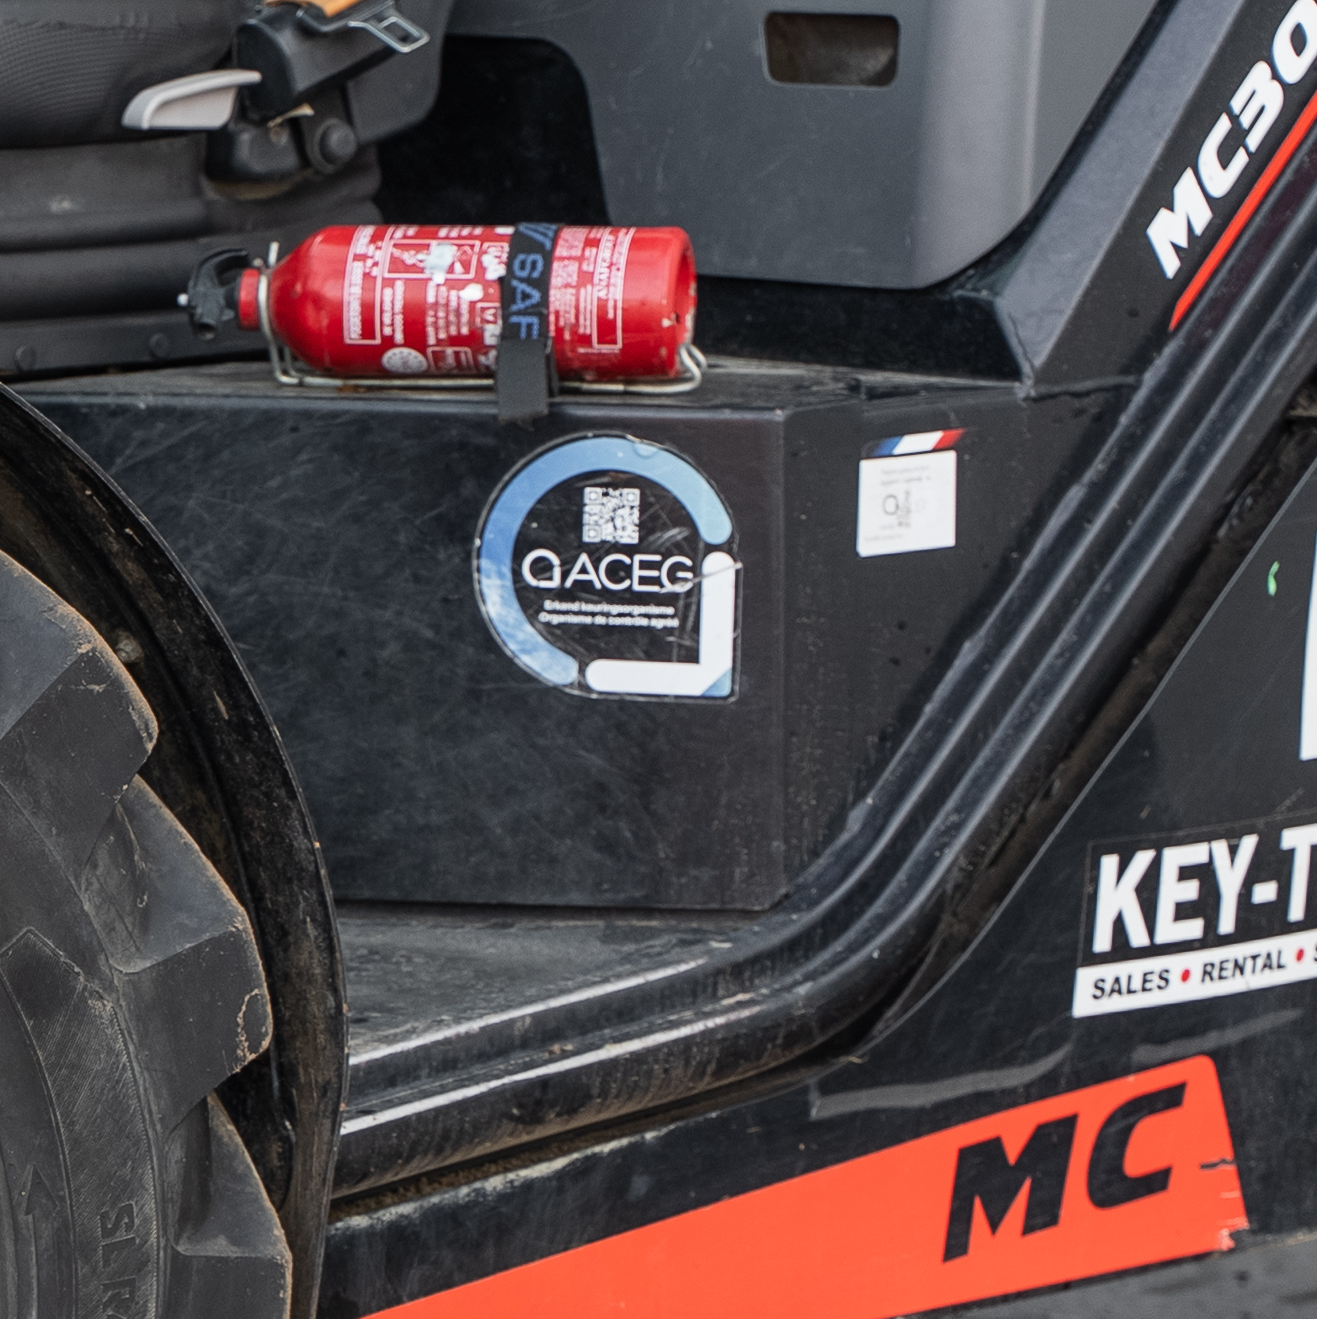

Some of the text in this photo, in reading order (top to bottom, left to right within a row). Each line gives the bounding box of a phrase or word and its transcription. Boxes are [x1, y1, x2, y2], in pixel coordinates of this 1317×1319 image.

[537, 610, 592, 627] Organisme
[1091, 968, 1171, 1001] SALES
[1200, 951, 1287, 985] RENTAL
[942, 1081, 1189, 1264] MC
